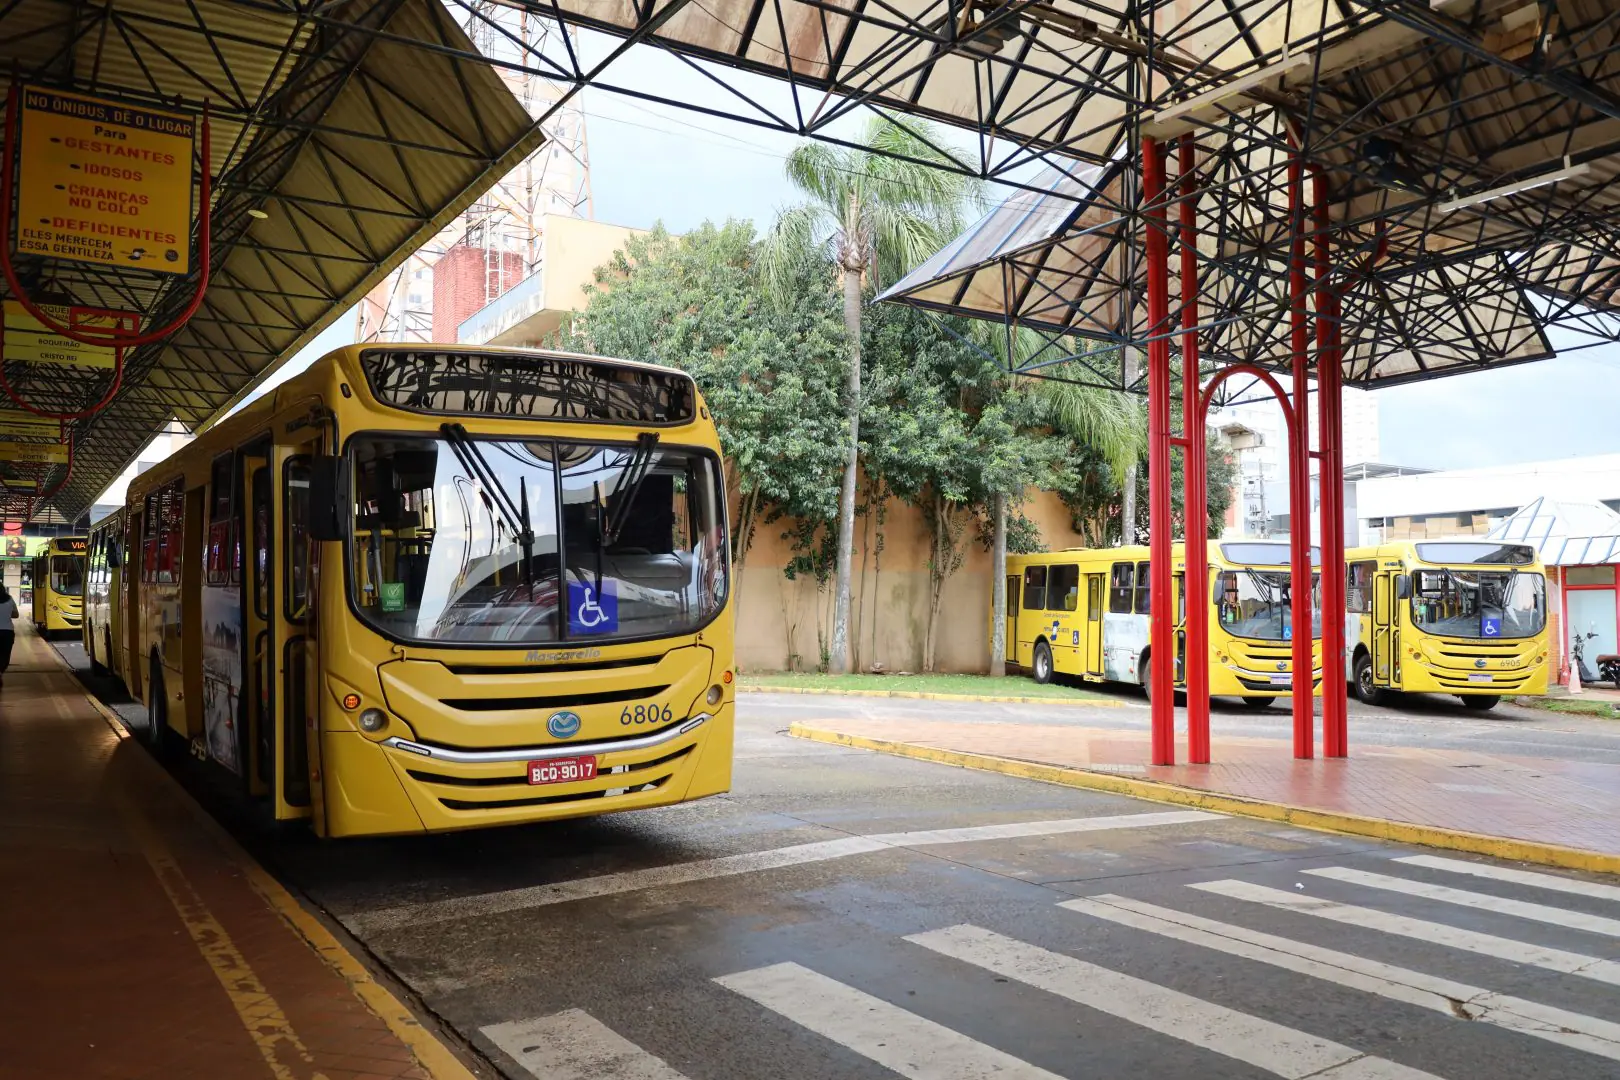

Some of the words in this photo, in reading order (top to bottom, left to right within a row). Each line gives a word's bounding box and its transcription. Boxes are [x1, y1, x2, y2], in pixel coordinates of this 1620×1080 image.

[28, 95, 48, 108] NO
[53, 98, 108, 121] ÔNIBUS,
[114, 109, 130, 124] DÊ
[136, 116, 144, 126] O
[149, 118, 192, 136] LUGAR
[94, 126, 126, 140] Para
[65, 137, 174, 165] GESTANTES
[84, 163, 142, 182] IDOSOS
[68, 184, 148, 205] CRIANÇAS
[69, 197, 92, 210] NO
[98, 200, 138, 216] COLO
[23, 228, 52, 240] ELES
[56, 233, 112, 249] MERECEM
[52, 218, 176, 244] DEFICIENTES
[20, 240, 48, 252] ESSA
[53, 244, 114, 260] GENTILEZA
[40, 352, 64, 360] CRISTO
[526, 647, 602, 662] Mascarello
[620, 702, 672, 725] 6806
